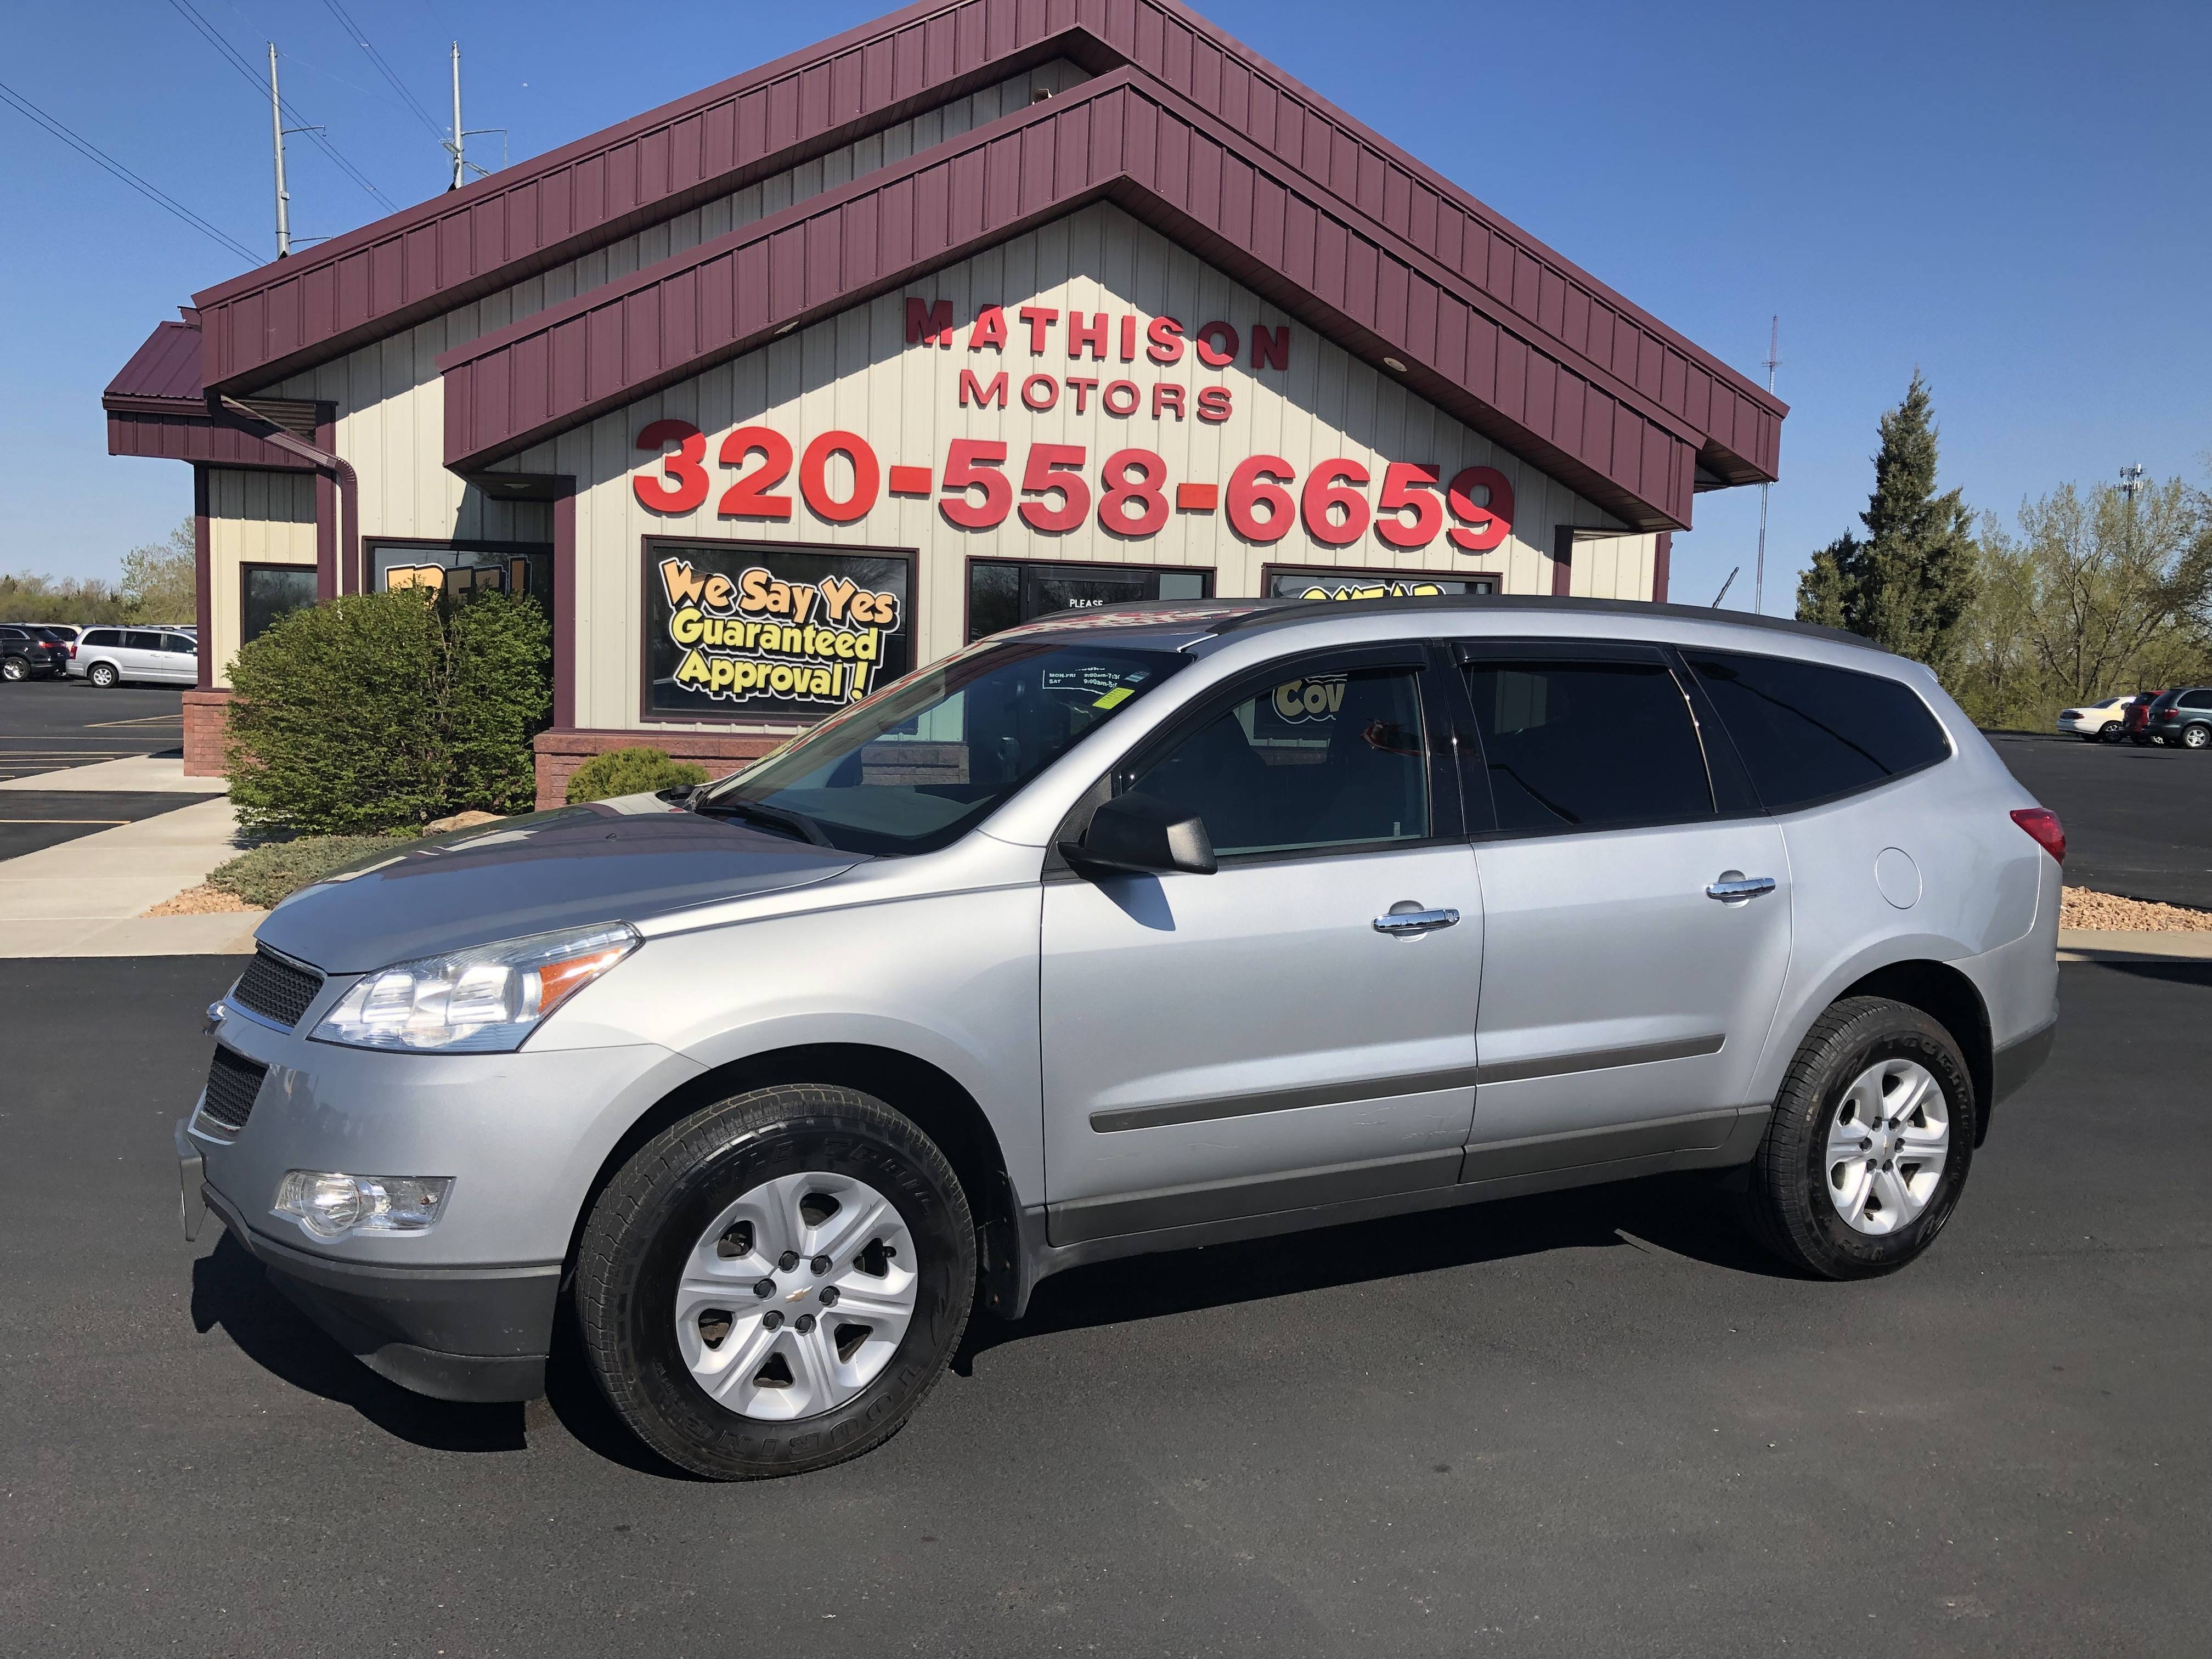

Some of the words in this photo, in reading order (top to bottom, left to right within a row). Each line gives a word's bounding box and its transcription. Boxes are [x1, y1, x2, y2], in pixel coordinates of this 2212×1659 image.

[906, 297, 1289, 371] MATHISON
[960, 369, 1233, 421] MOTORS
[633, 419, 1515, 551] 320-558-6659
[661, 558, 731, 607] We
[738, 568, 815, 623] Say
[821, 577, 894, 624] Yes
[1069, 599, 1103, 608] PLEASE
[672, 606, 879, 661] Guaranteed
